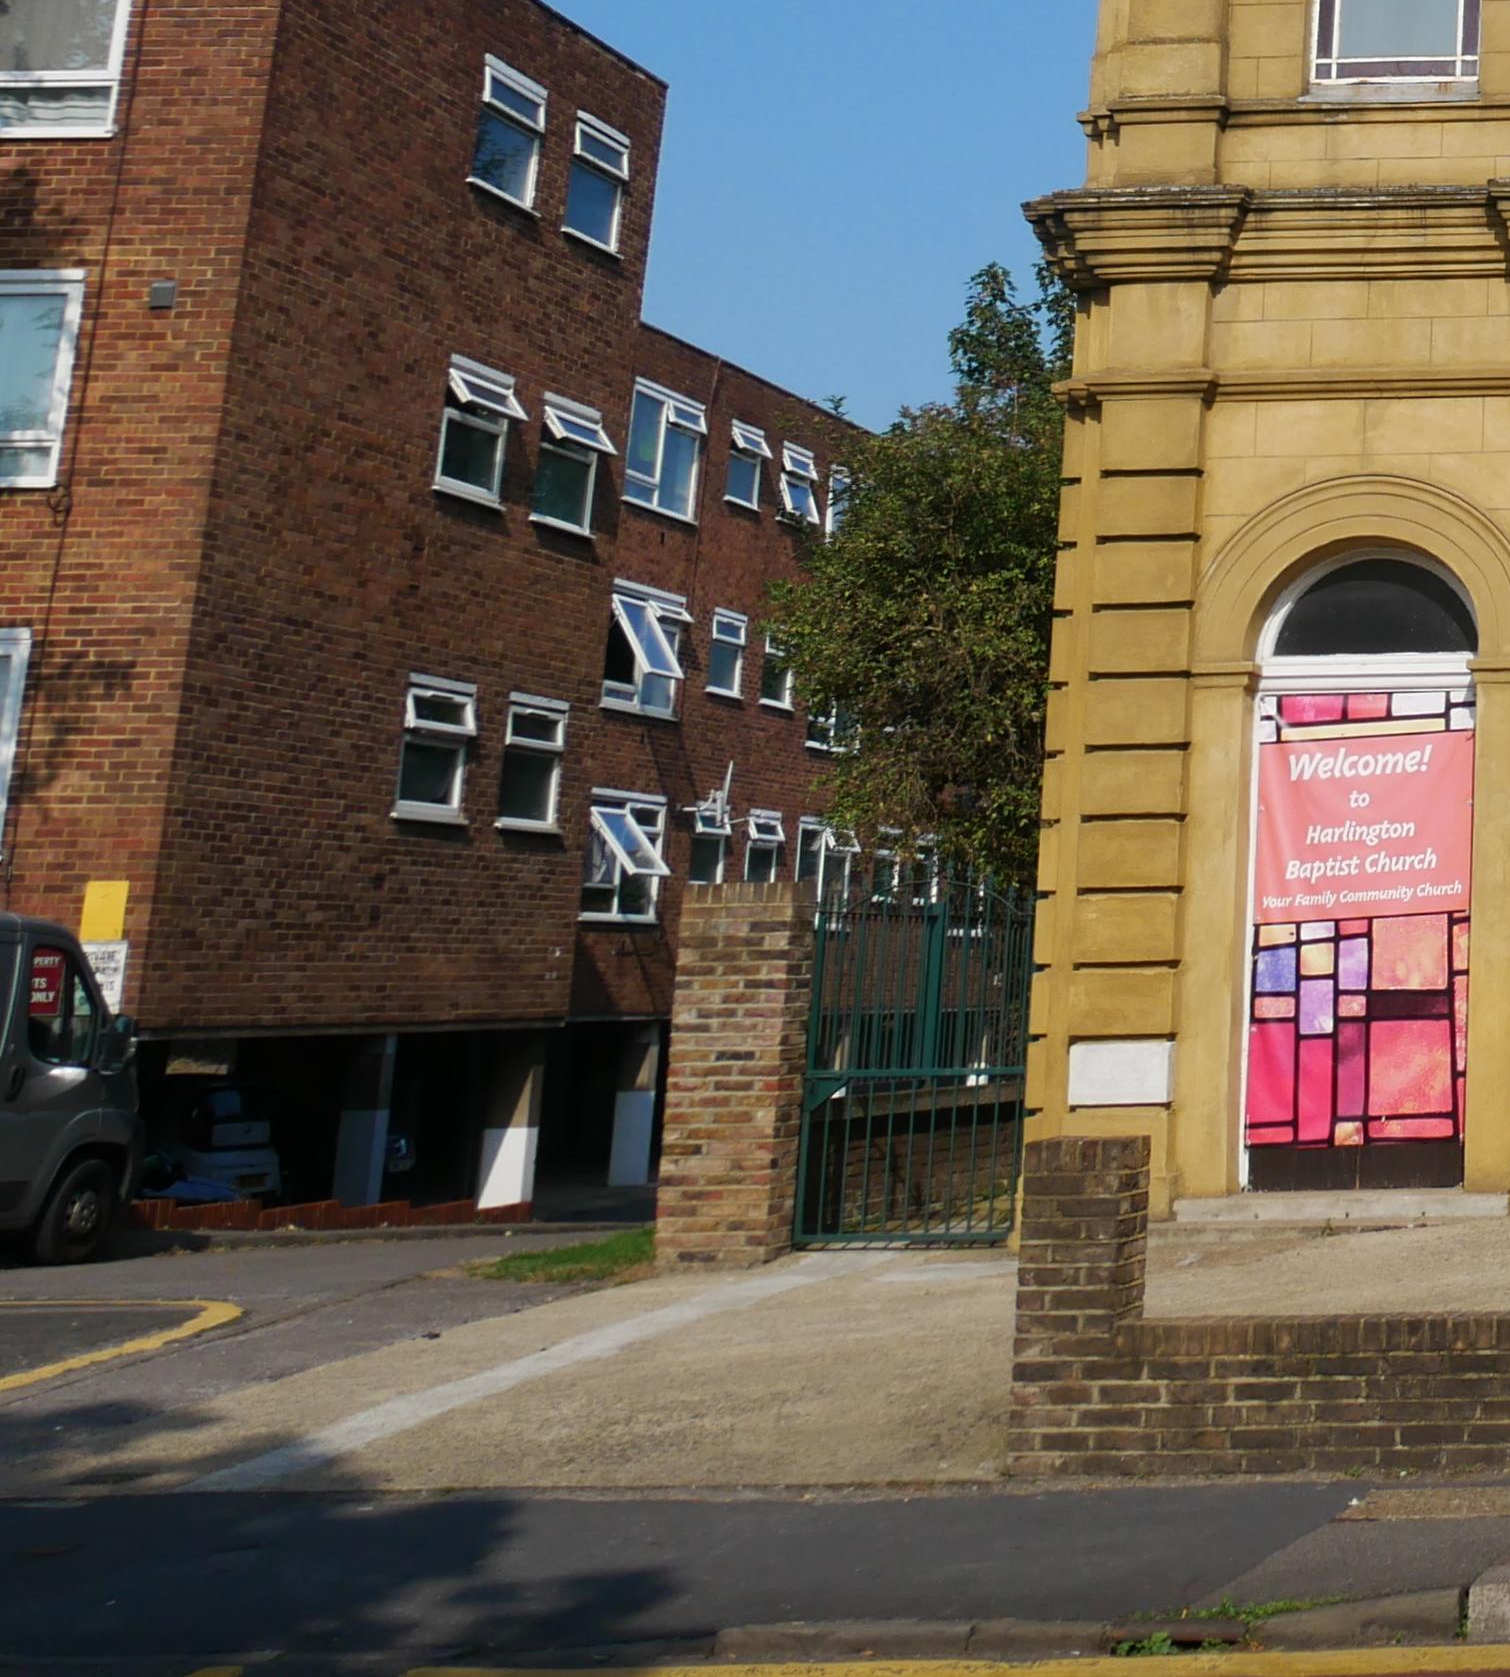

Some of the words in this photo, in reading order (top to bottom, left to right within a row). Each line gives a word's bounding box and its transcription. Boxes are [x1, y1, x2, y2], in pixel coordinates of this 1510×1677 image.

[1289, 745, 1432, 781] Welcome!
[1349, 790, 1369, 807] to
[1306, 821, 1415, 846] Harlington
[1285, 856, 1360, 883] Baptist
[1365, 848, 1437, 873] Church
[1262, 895, 1292, 908] Your
[1295, 891, 1336, 907] Family
[1339, 886, 1414, 903] Community
[1416, 880, 1462, 897] Church
[33, 956, 60, 967] PERTY
